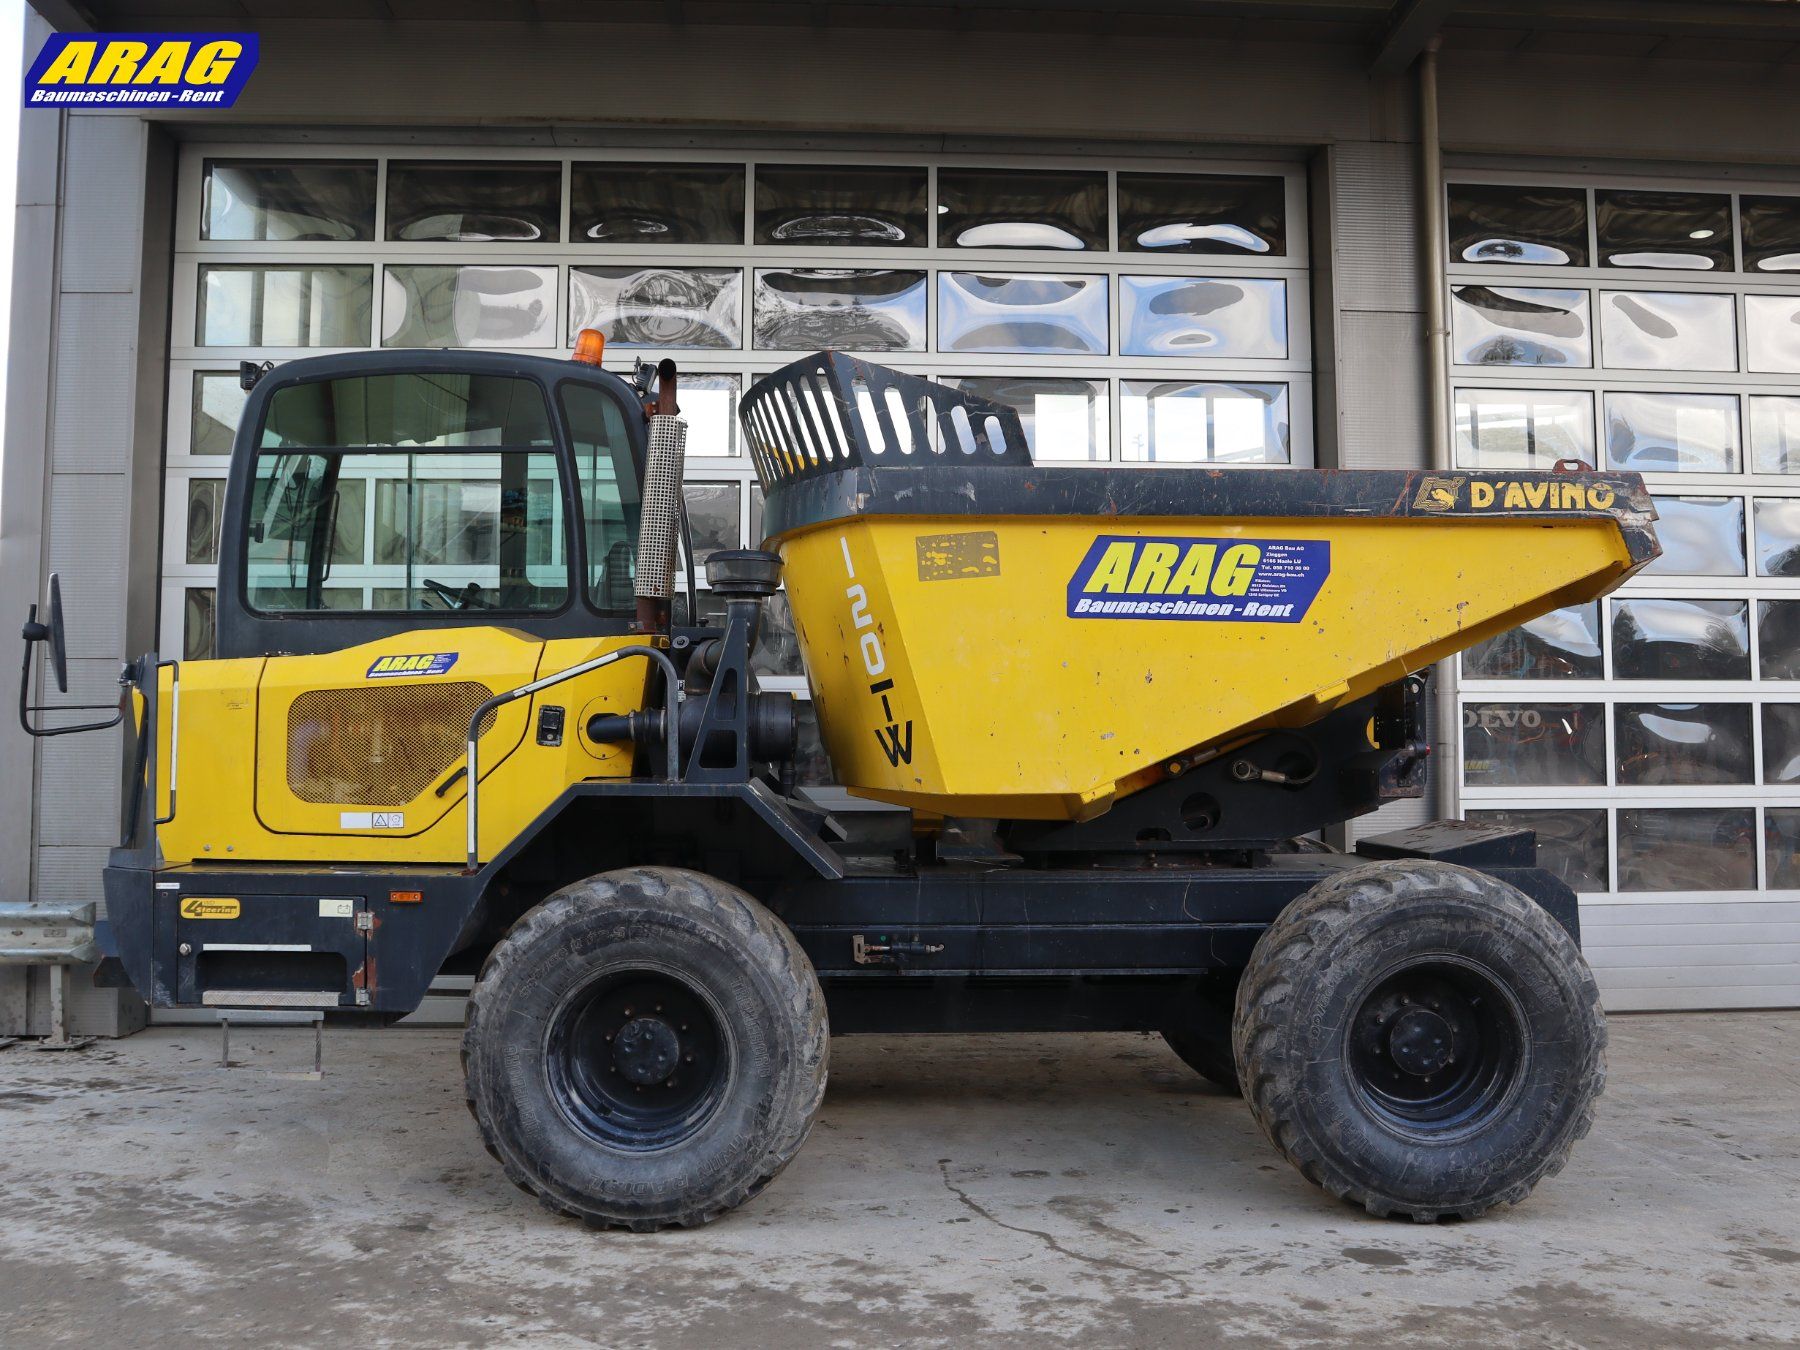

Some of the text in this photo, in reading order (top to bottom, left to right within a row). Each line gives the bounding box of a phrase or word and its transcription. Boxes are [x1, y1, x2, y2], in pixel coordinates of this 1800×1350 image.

[1083, 541, 1262, 597] ARAG
[1074, 597, 1295, 618] Baumaschinen-Rent
[373, 654, 435, 672] ARAG
[1462, 709, 1542, 728] OLVO
